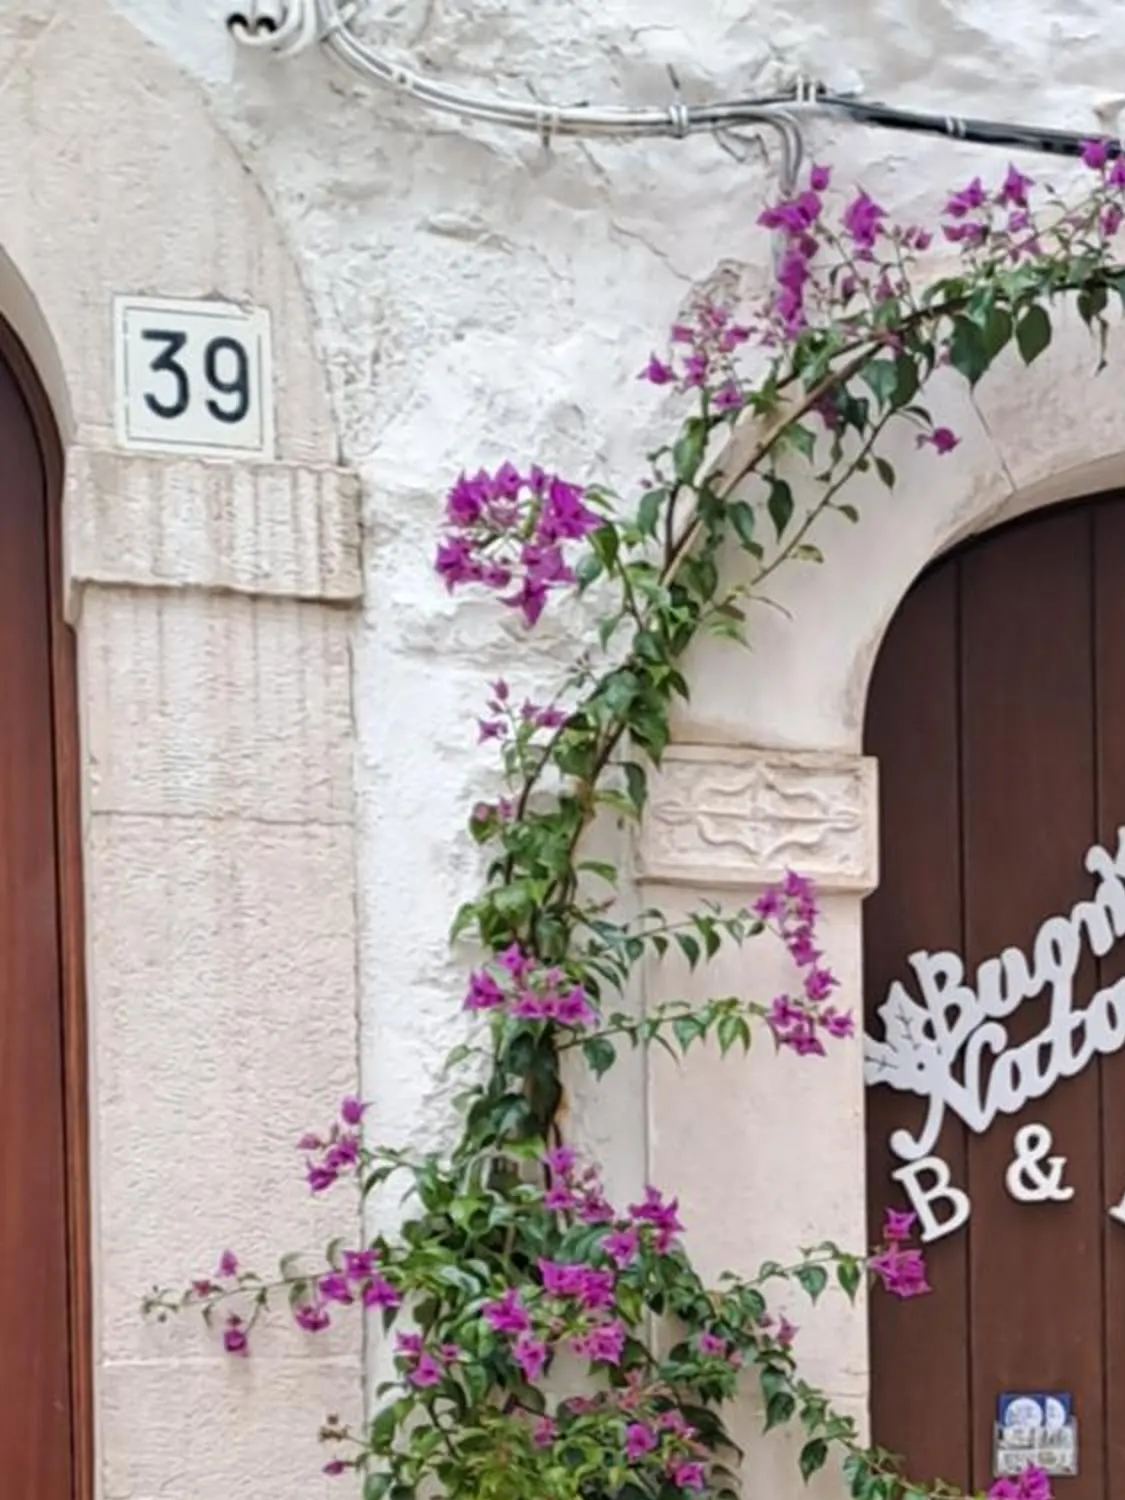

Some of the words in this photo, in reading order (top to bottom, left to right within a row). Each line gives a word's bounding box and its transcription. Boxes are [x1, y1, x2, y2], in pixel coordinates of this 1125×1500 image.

[141, 329, 249, 424] 39
[893, 1156, 971, 1242] B
[1006, 1124, 1075, 1202] &
